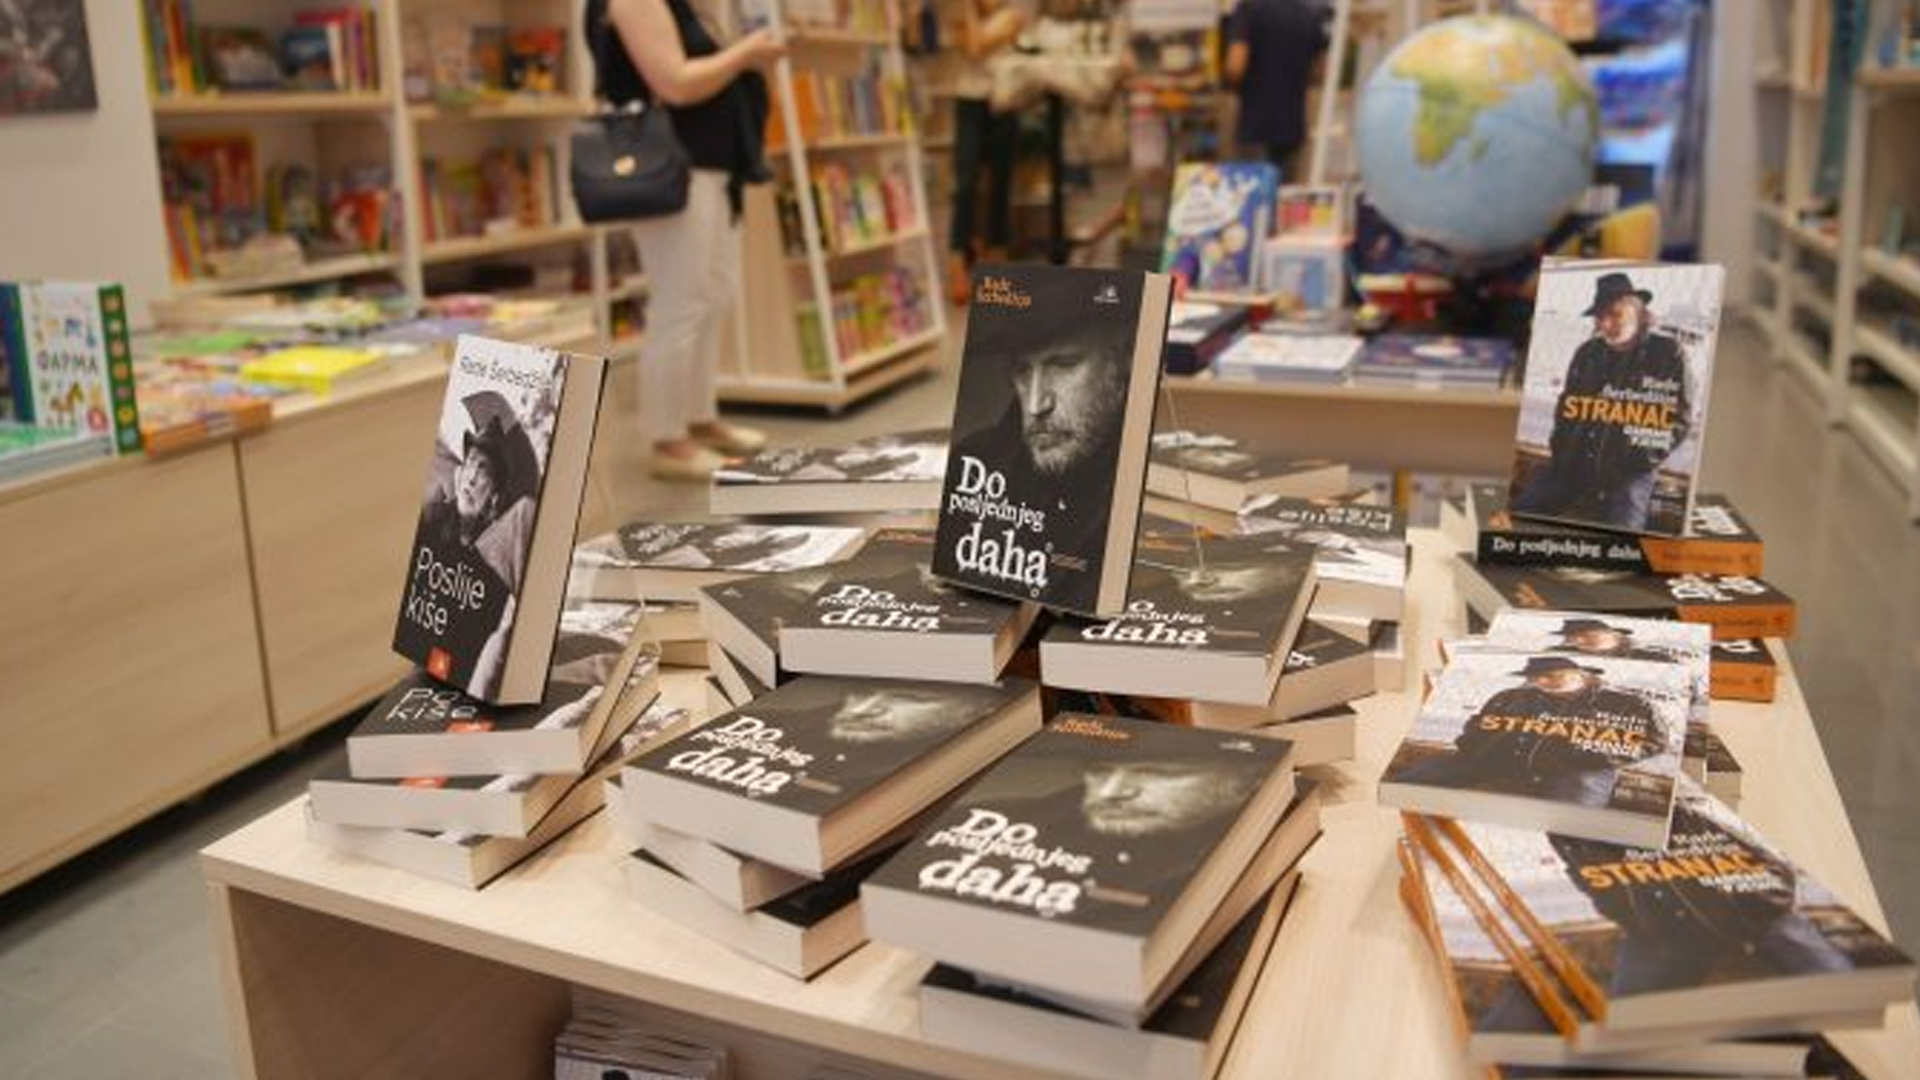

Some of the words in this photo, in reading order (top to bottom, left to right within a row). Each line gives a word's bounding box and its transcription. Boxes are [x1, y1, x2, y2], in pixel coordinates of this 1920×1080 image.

[36, 348, 99, 375] ФАРМА
[1563, 395, 1677, 430] STRANAC
[956, 456, 1006, 498] Do
[948, 492, 1046, 533] posljednjeg
[955, 522, 1048, 588] daha
[1494, 537, 1515, 551] Do
[414, 547, 485, 610] Poslije
[829, 585, 896, 602] Do
[405, 583, 449, 636] kiše
[820, 607, 941, 632] daha
[1081, 619, 1210, 645] daha
[715, 715, 784, 743] Do
[1479, 714, 1647, 745] STRANAC
[664, 746, 792, 795] daha
[949, 808, 1038, 845] Do
[926, 830, 1093, 875] posljednjeg
[1579, 852, 1766, 888] STRANAC
[918, 853, 1082, 918] daha
